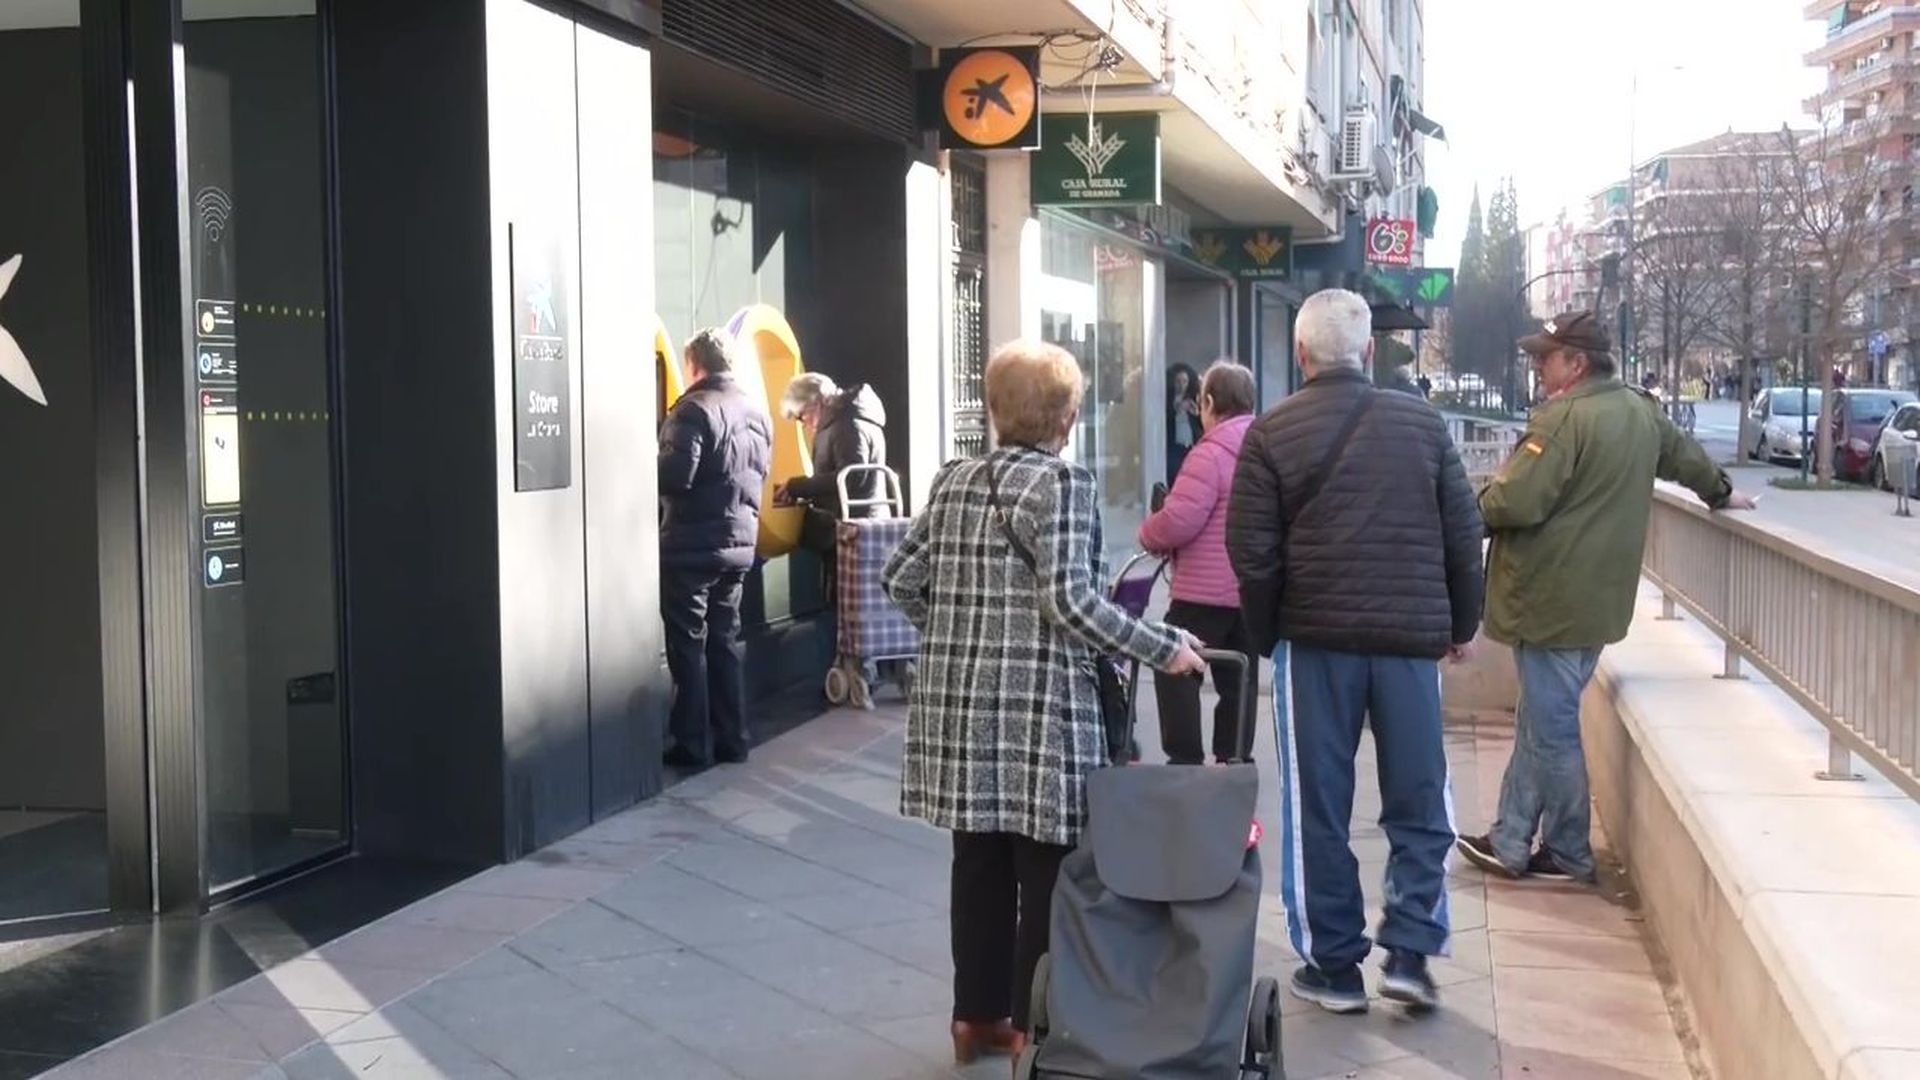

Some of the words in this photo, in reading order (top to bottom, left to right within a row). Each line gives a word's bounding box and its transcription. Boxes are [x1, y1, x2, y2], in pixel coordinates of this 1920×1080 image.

[1061, 178, 1087, 189] CAJA
[1090, 178, 1127, 188] RURAL
[529, 390, 558, 413] Store
